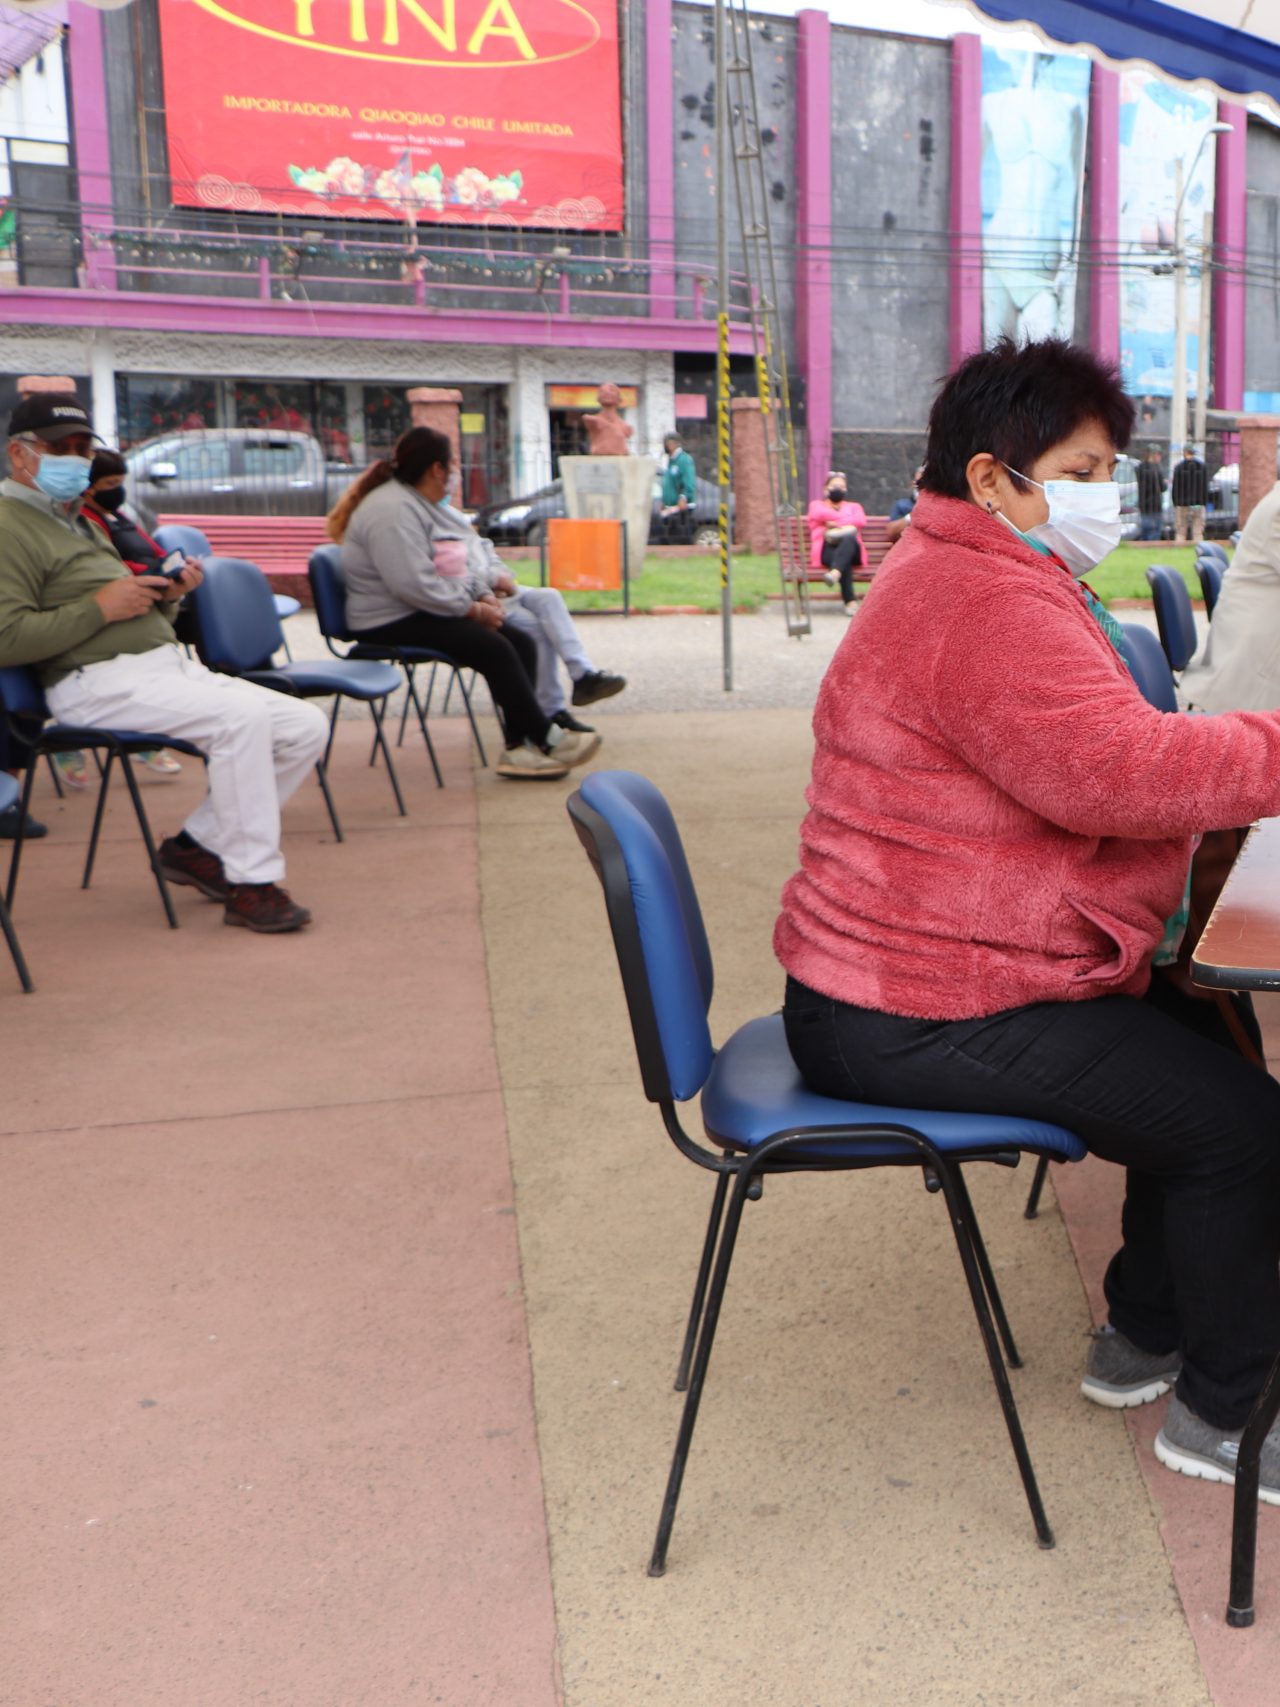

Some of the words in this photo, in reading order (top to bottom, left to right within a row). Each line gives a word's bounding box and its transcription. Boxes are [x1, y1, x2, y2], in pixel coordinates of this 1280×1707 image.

[293, 0, 537, 60] YINA
[224, 95, 352, 118] IMPORTADORA
[359, 107, 445, 127] QIAOQIAO
[452, 115, 495, 132] CHILE
[502, 120, 574, 137] LIMITADA
[52, 406, 88, 419] PUMA
